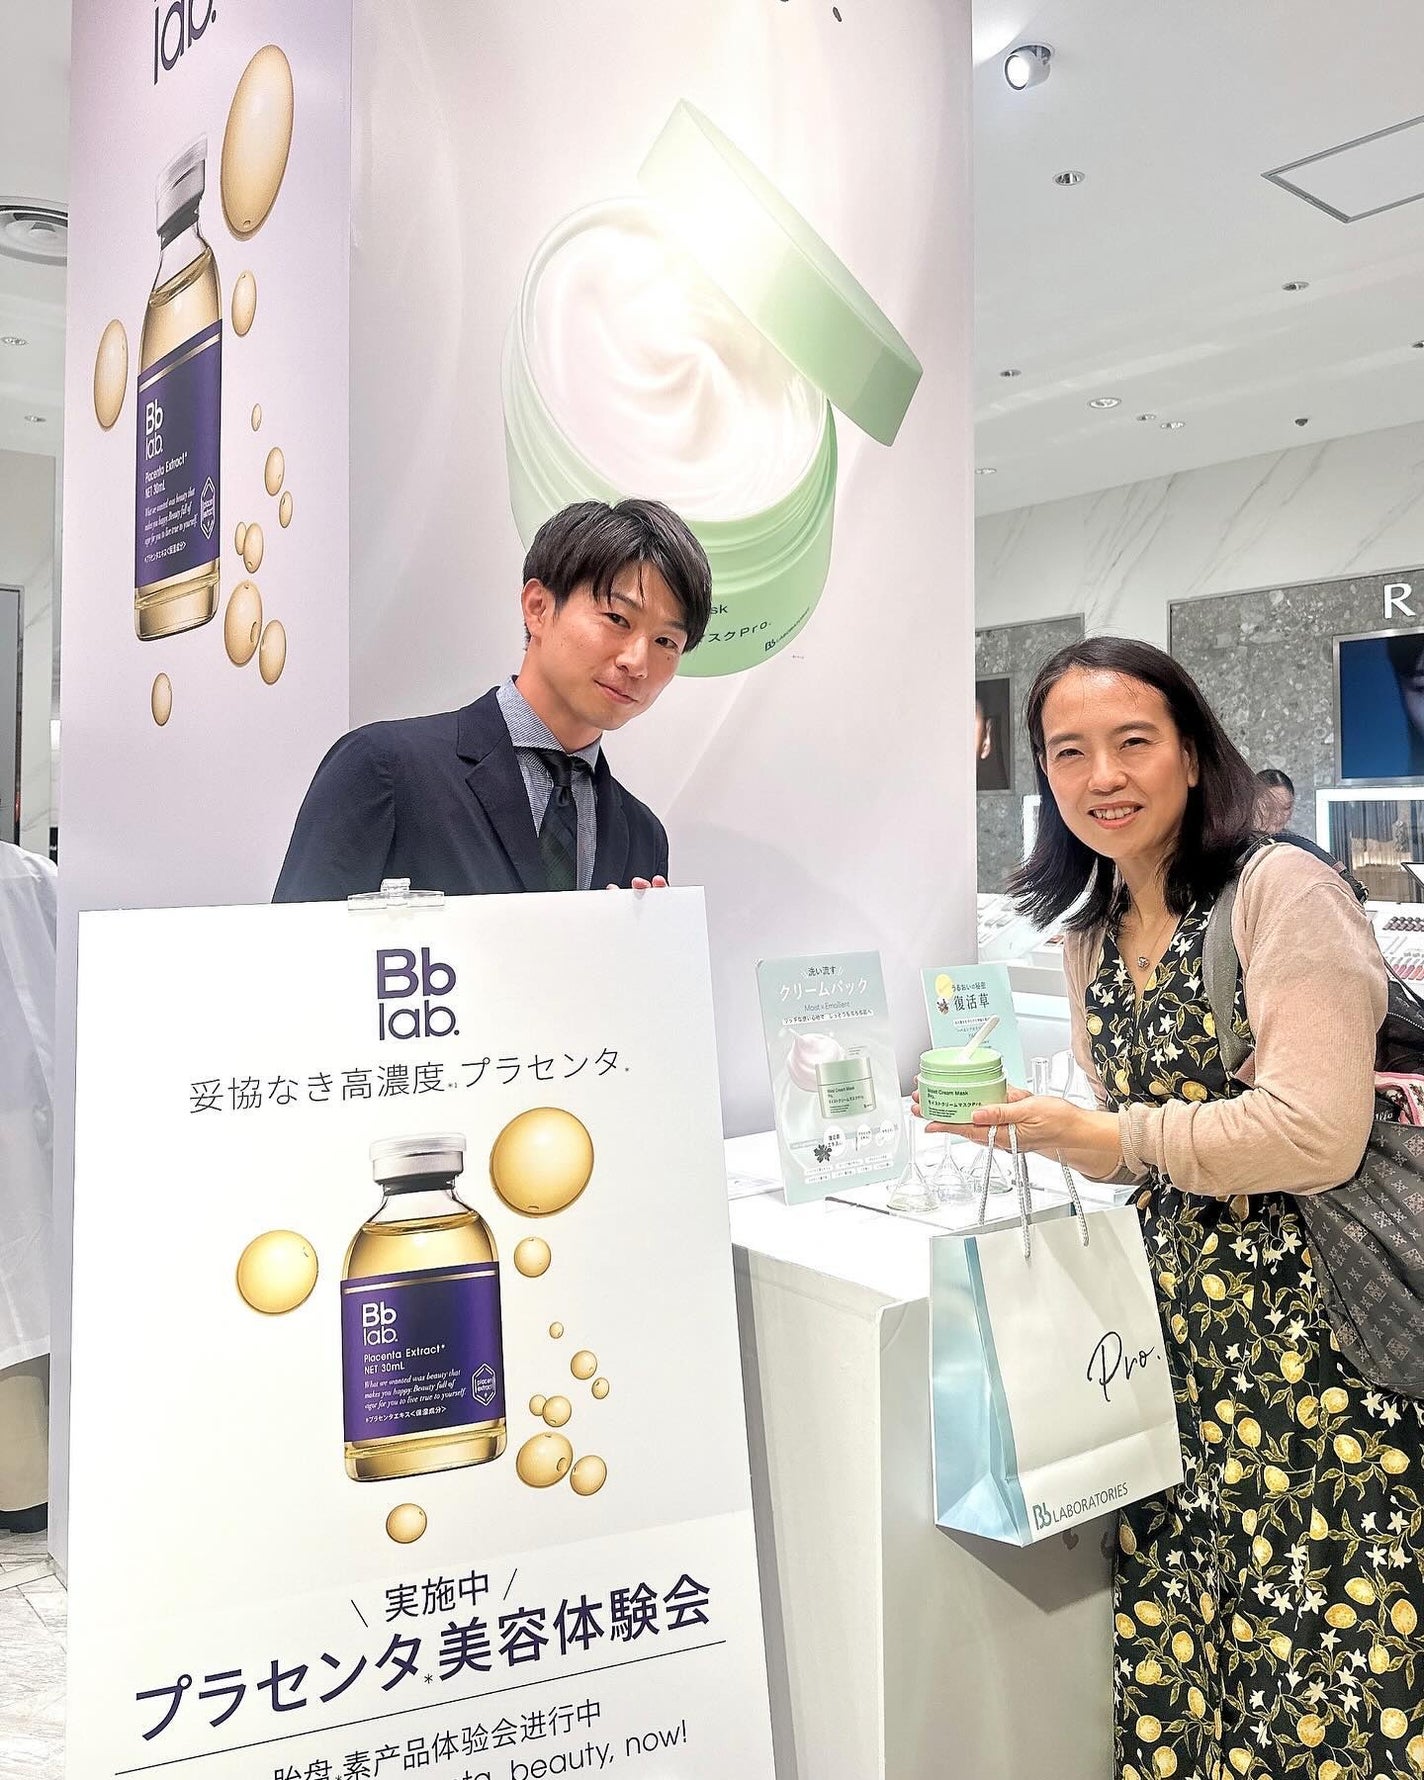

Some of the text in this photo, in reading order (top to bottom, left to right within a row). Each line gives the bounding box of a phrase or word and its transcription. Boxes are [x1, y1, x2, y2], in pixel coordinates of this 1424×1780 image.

[145, 399, 164, 436] Bb
[145, 434, 164, 461] lab.
[710, 604, 729, 615] sk
[376, 946, 457, 1000] Bb
[779, 977, 868, 1002] クリームパック
[953, 992, 990, 1011] 復活草
[378, 999, 460, 1041] lab.
[362, 1301, 397, 1328] Bb
[363, 1326, 399, 1347] lab.
[364, 1350, 402, 1363] Placenta
[364, 1361, 406, 1375] NET 30mL
[1087, 1331, 1161, 1402] Pro.
[1053, 1482, 1129, 1523] LABORATORIES
[385, 1570, 489, 1623] 実施中
[510, 1719, 688, 1780] beauty, now!
